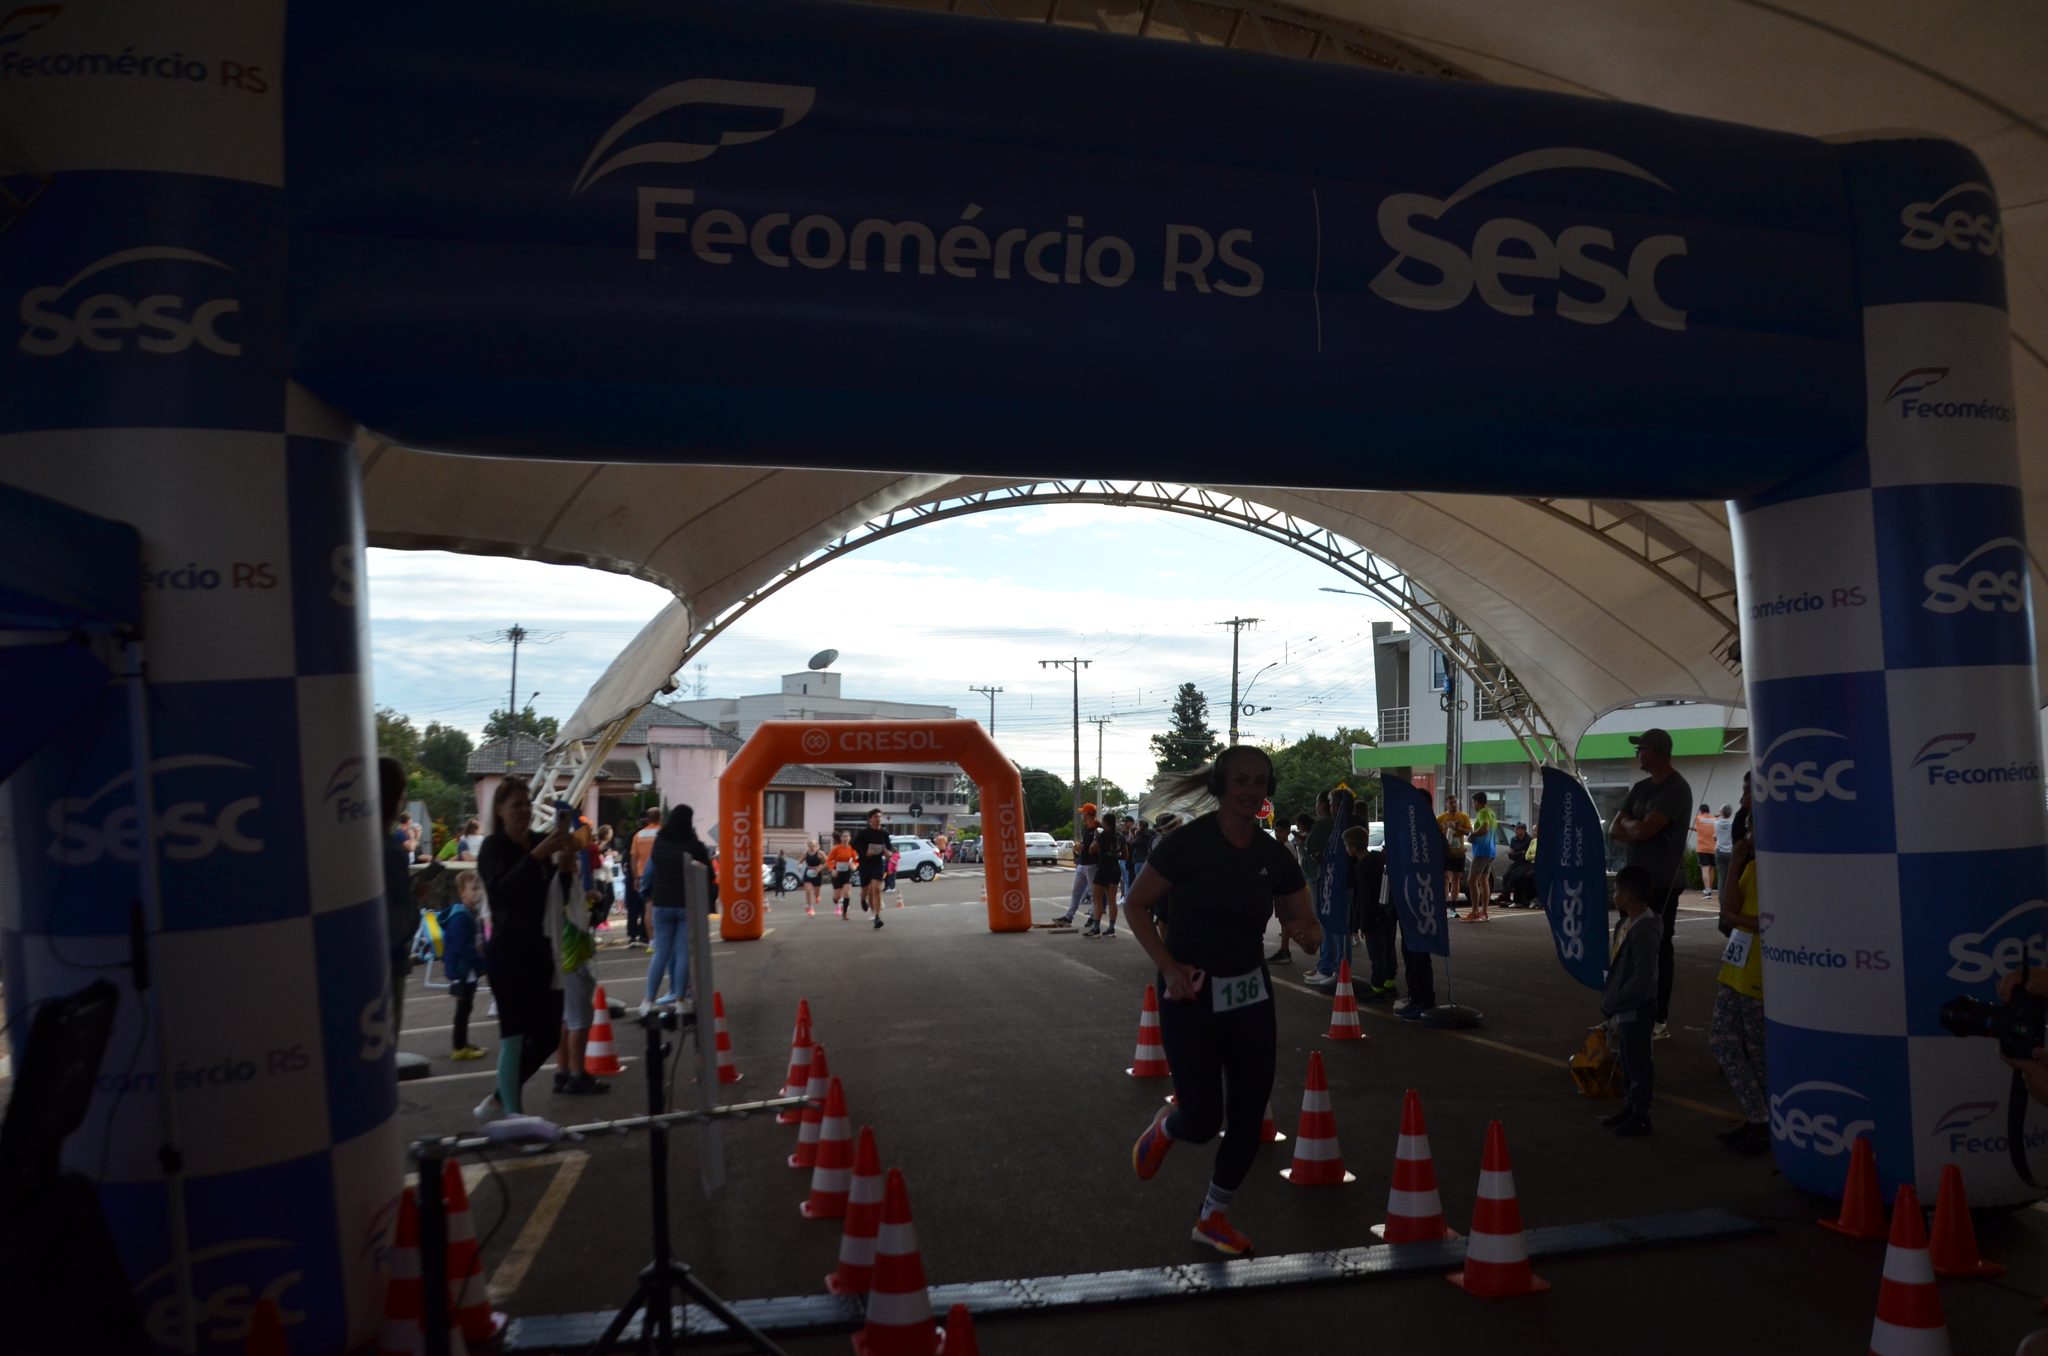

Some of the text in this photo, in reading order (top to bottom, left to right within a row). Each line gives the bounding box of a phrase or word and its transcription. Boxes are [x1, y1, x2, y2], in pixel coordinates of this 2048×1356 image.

[2, 46, 268, 94] Fecomércio RS
[636, 186, 1265, 298] Fecomércio RS
[1899, 201, 1999, 256] Ses
[140, 561, 278, 592] ércio RS
[1921, 564, 2022, 614] Ses
[1751, 586, 1868, 619] omércio RS
[839, 730, 944, 752] CRESOL
[733, 805, 752, 893] CRESOL
[1000, 797, 1020, 883] CRESOL
[1855, 949, 1891, 971] RS
[1946, 932, 2048, 982] Ses
[1221, 976, 1259, 1006] 136
[267, 1045, 310, 1076] RS
